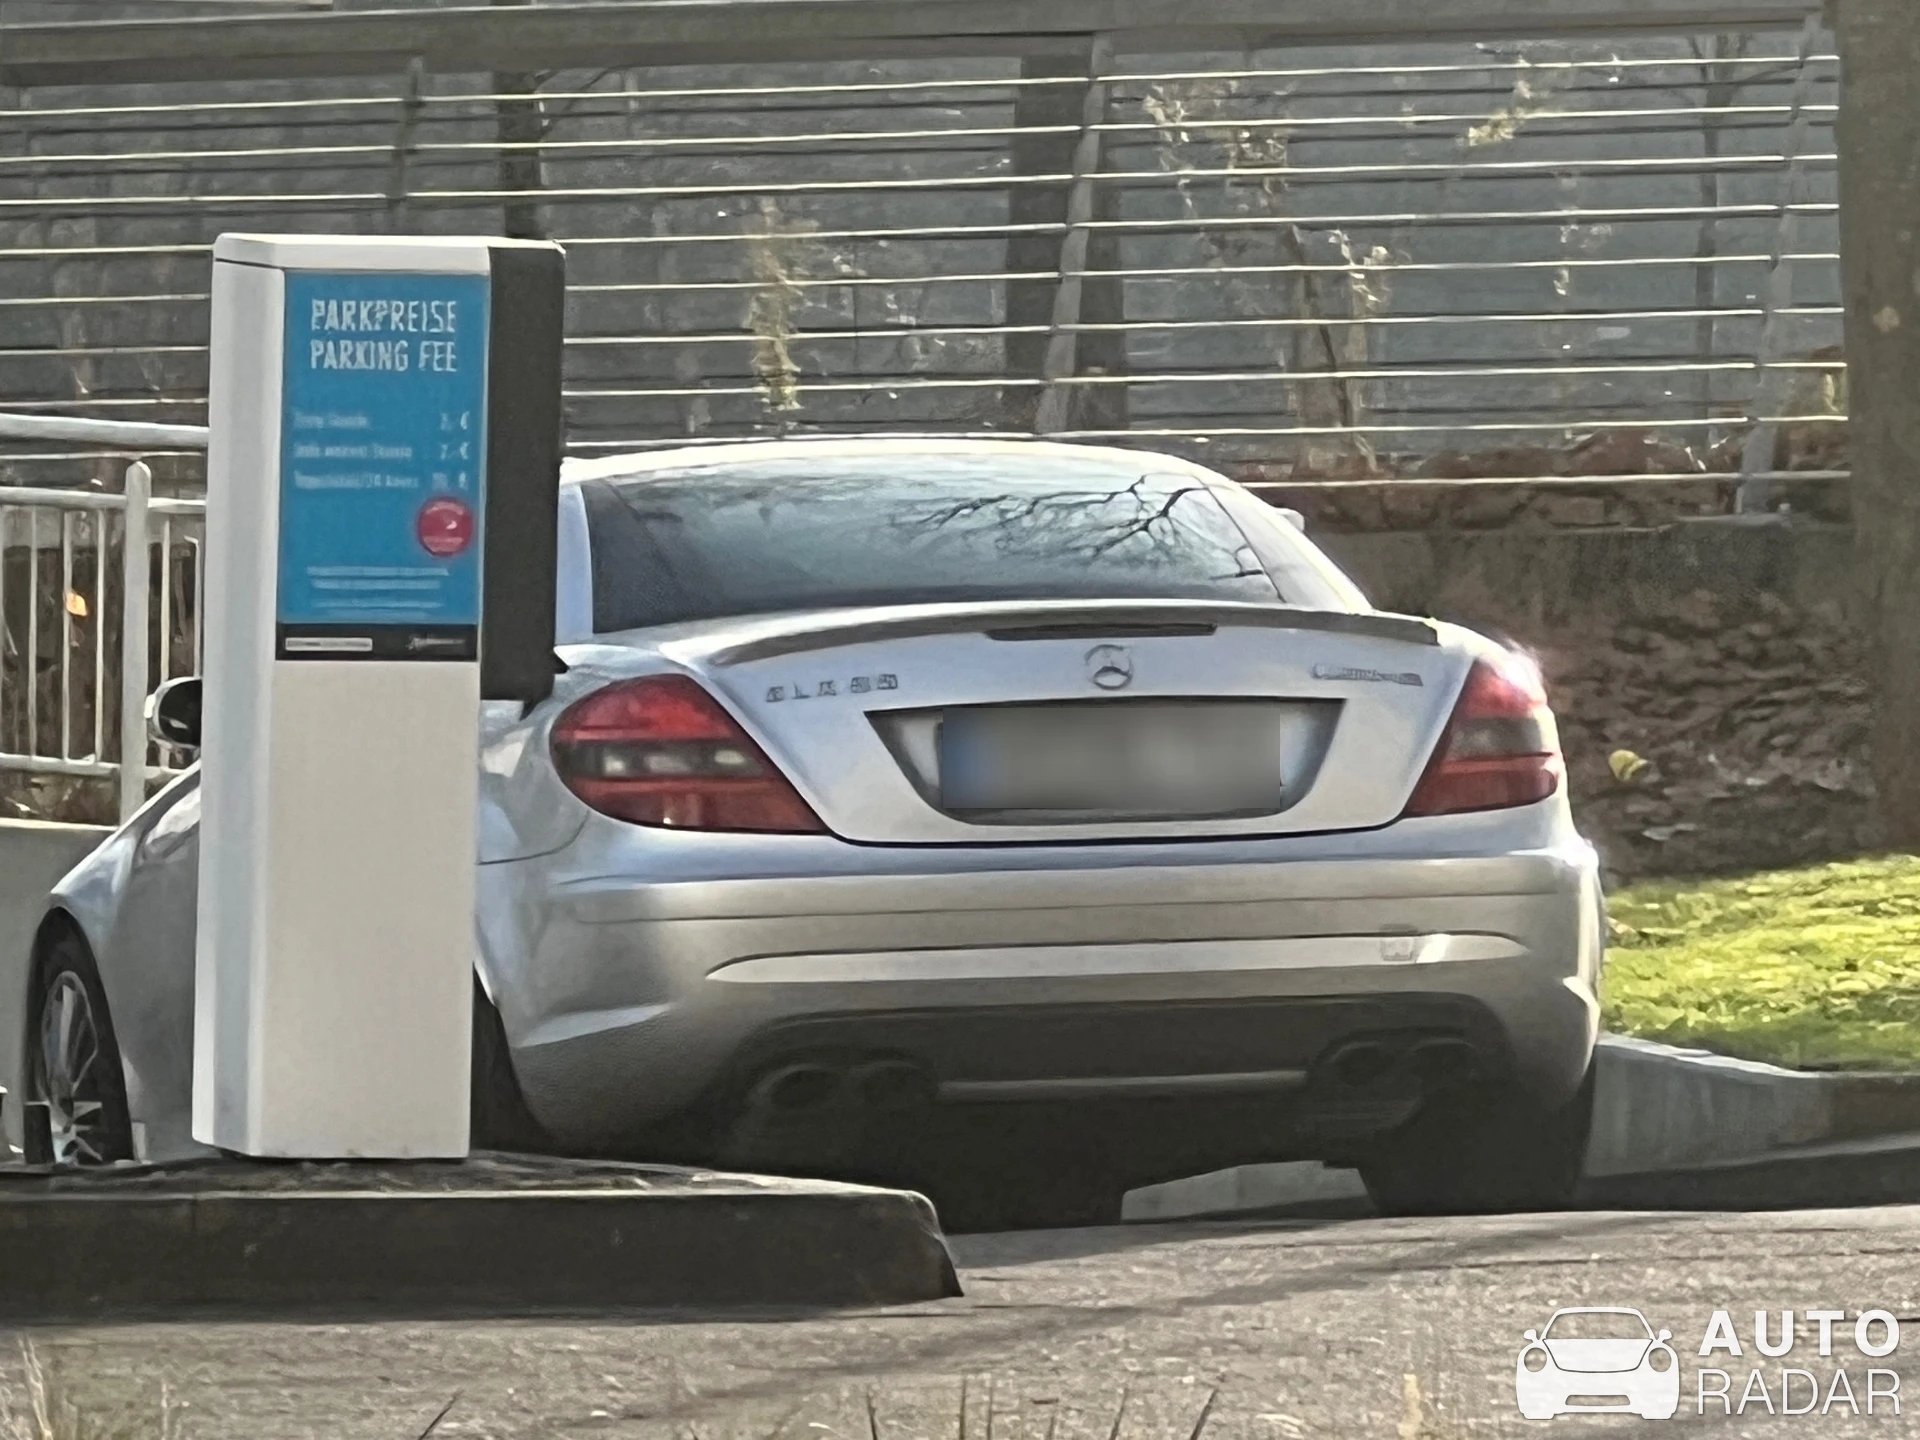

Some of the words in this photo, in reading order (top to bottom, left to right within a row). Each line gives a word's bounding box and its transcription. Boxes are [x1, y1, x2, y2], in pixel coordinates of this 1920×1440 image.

[311, 299, 457, 333] PARKPREISE
[311, 340, 409, 372] PARKING
[418, 341, 458, 372] FEE
